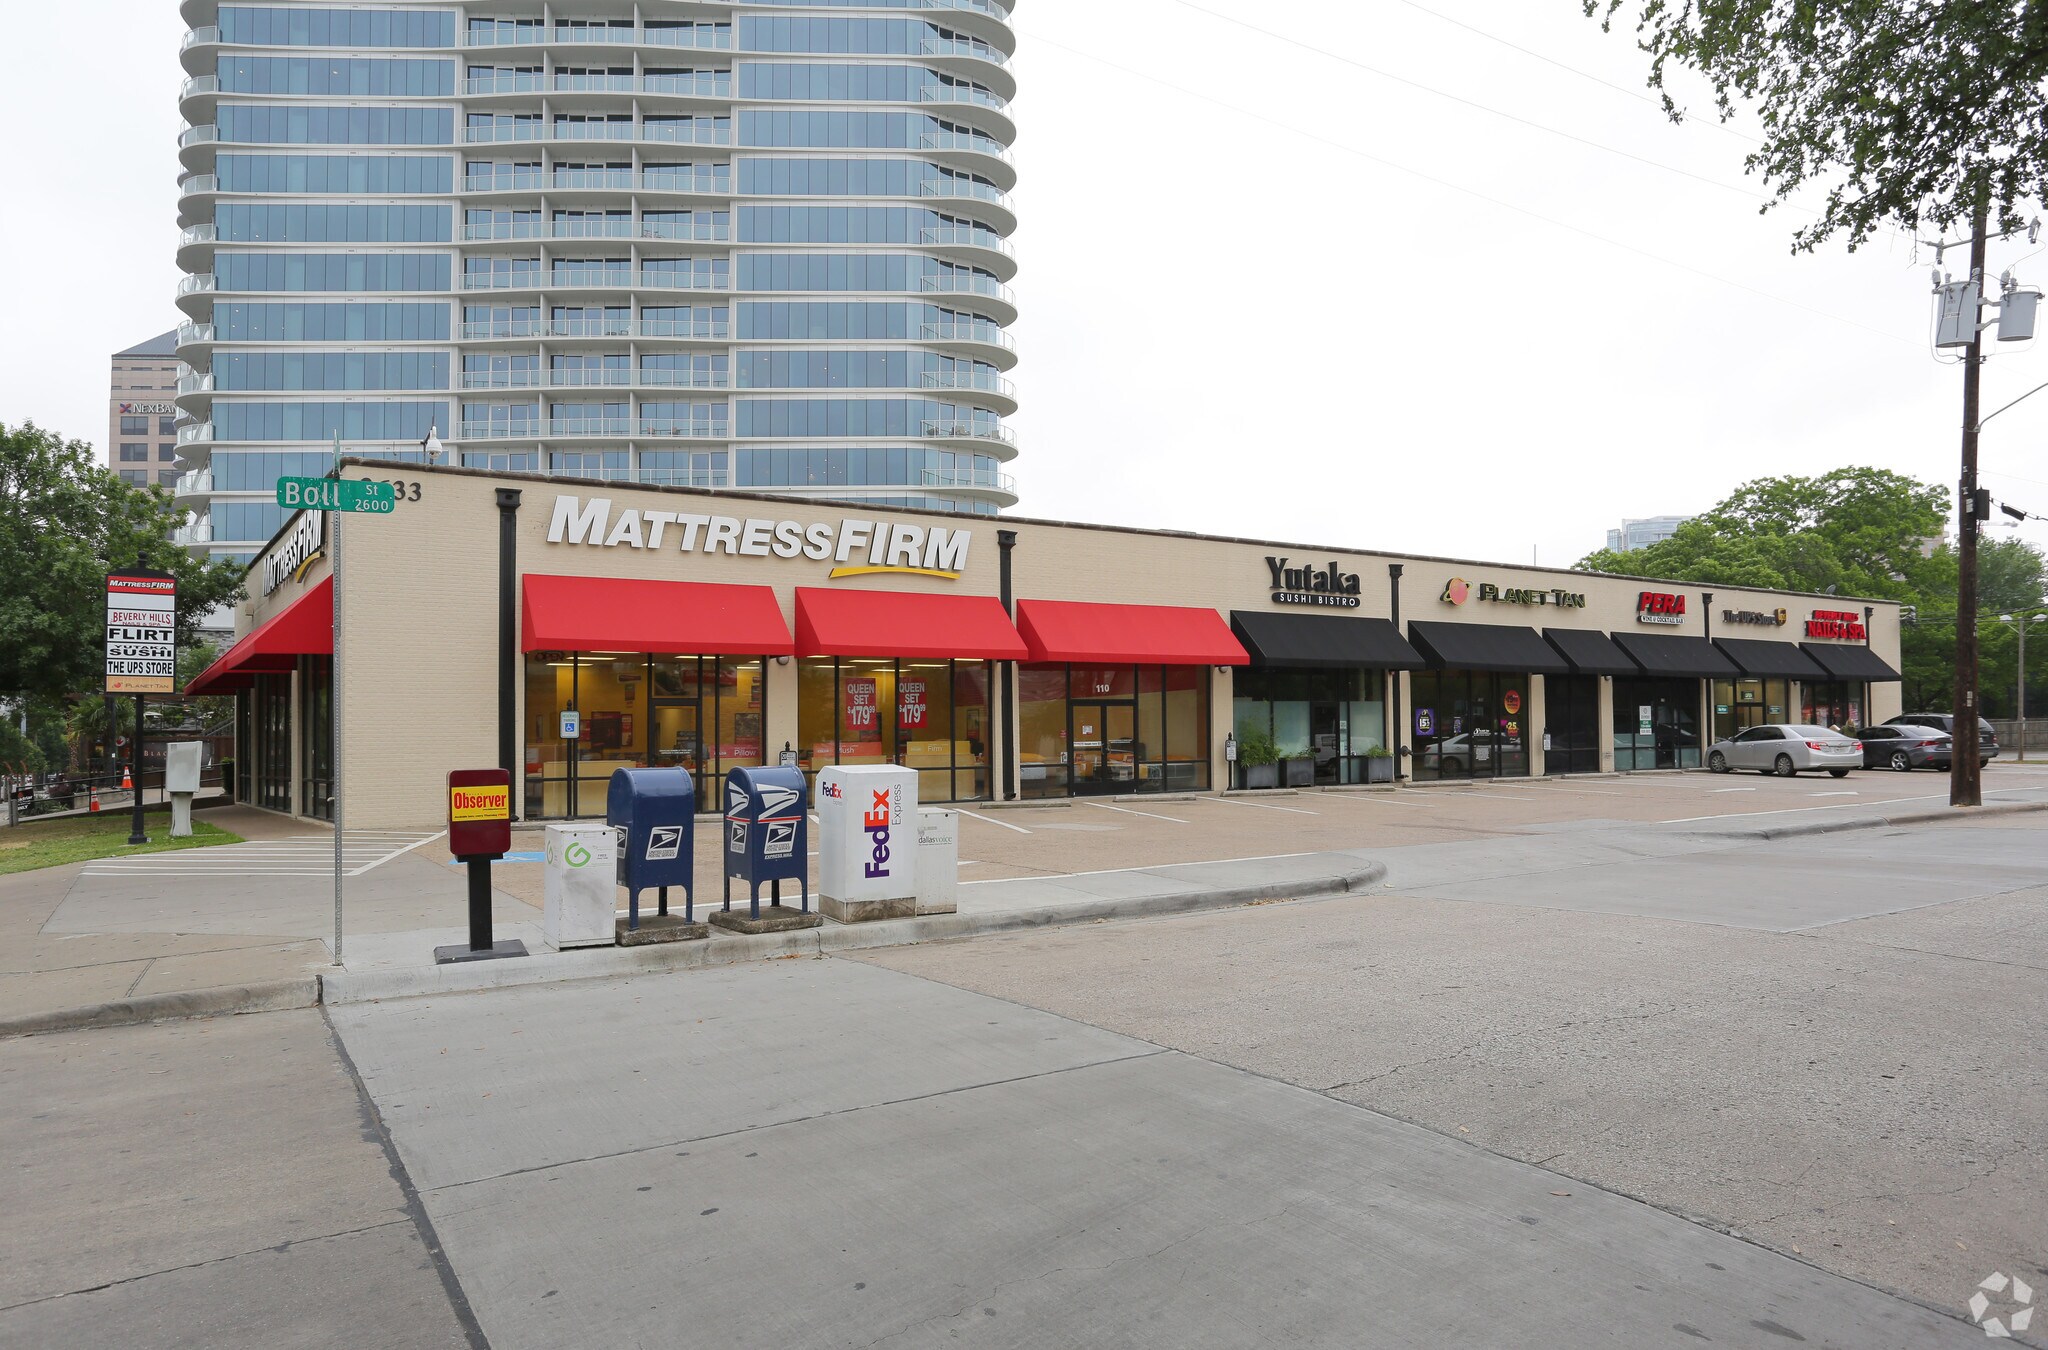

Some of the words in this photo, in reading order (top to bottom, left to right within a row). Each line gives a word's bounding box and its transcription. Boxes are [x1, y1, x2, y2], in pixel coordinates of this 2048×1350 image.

[133, 403, 177, 413] NEXBAN
[285, 482, 340, 507] Boll
[366, 485, 378, 496] St
[355, 499, 389, 511] 2600
[546, 494, 972, 571] MATTRESSFIRM
[1265, 556, 1361, 594] Yutaka
[1280, 593, 1312, 604] SUSHI
[1318, 597, 1356, 607] BISTRO
[1479, 583, 1550, 606] PLANET
[1551, 589, 1586, 608] TAN
[1637, 592, 1686, 614] PERA
[113, 612, 147, 622] BEVERLY
[149, 613, 171, 624] HILLS
[1723, 610, 1739, 623] The
[109, 629, 173, 641] FLIRT
[1805, 621, 1839, 638] NAILS
[1839, 623, 1847, 638] &
[1847, 623, 1867, 639] SPA
[109, 649, 172, 657] SUSHI
[108, 661, 125, 673] THE
[127, 661, 144, 674] UPS
[146, 662, 173, 675] STORE
[847, 683, 875, 694] QUEEN
[898, 682, 925, 693] QUEEN
[1095, 684, 1110, 693] 110
[854, 695, 869, 705] SET
[904, 693, 920, 704] SET
[822, 781, 843, 799] FedEx
[453, 792, 507, 809] Observer
[891, 783, 904, 826] Express
[864, 788, 890, 879] FedEx
